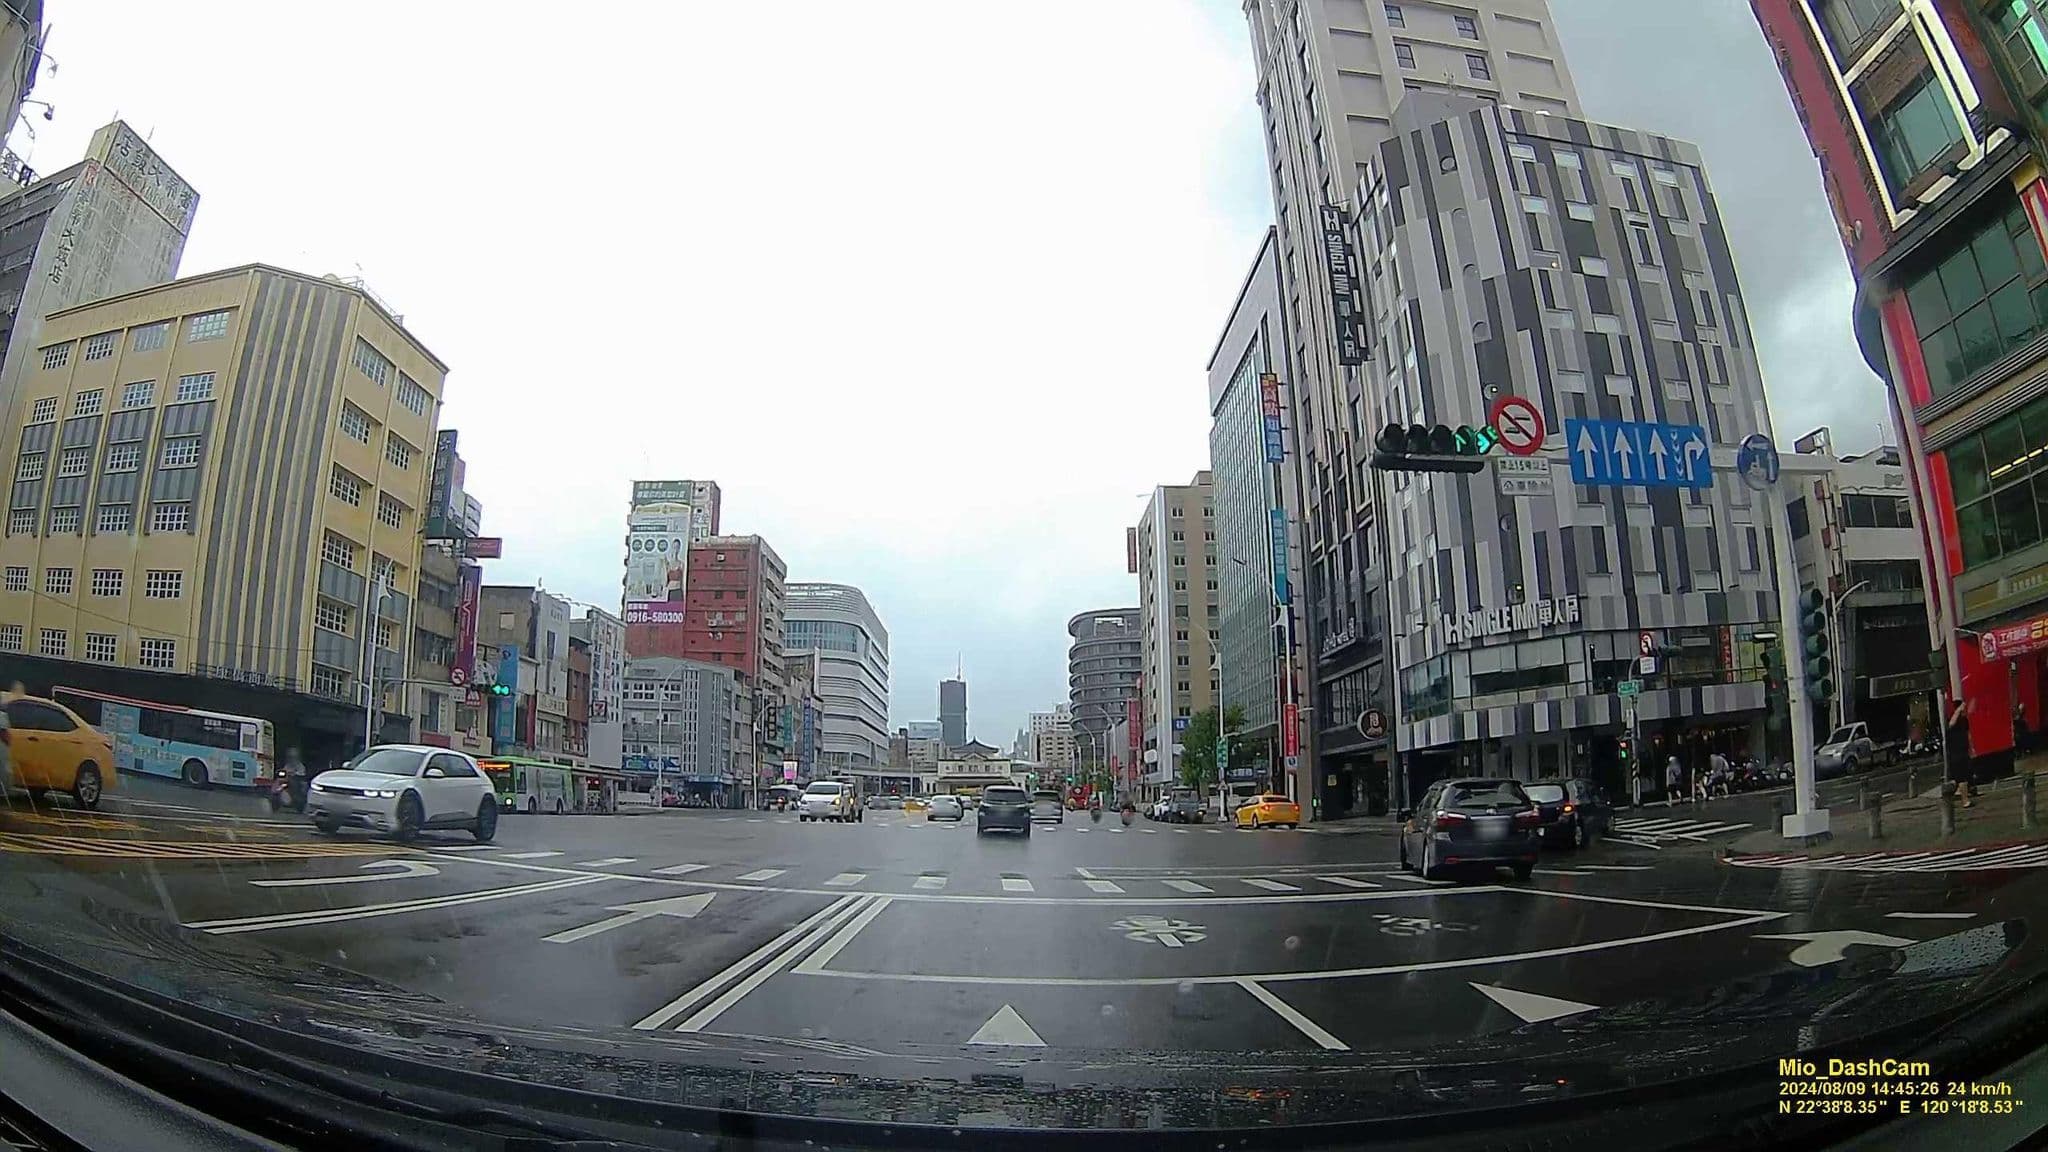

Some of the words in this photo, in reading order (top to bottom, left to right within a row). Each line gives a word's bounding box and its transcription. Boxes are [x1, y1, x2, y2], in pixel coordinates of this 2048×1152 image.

[1327, 234, 1346, 273] SINGLE
[1333, 274, 1350, 295] INN
[1464, 606, 1512, 638] SINGLE
[1511, 601, 1539, 631] INN
[1539, 594, 1579, 626] 單人房
